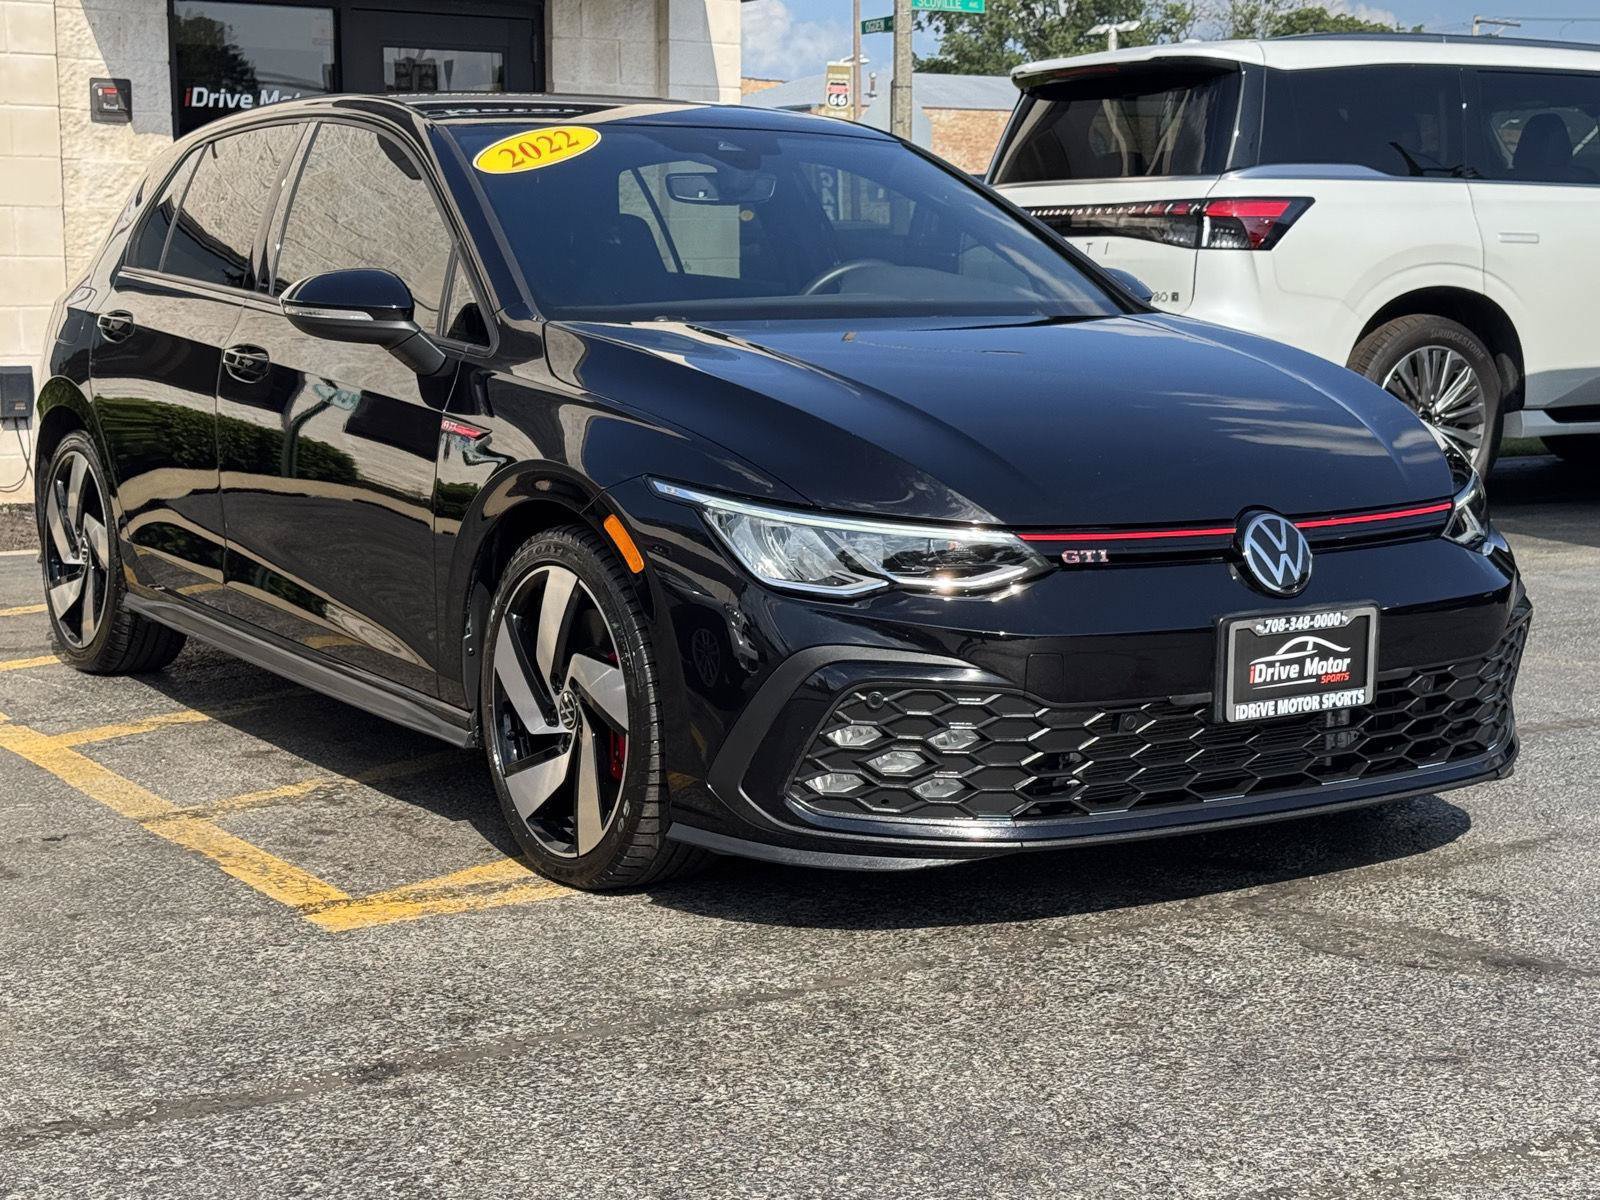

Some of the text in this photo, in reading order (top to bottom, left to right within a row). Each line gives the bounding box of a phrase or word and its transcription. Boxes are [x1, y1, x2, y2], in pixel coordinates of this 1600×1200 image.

[184, 87, 254, 109] iDrive
[829, 94, 847, 106] 66
[498, 130, 580, 168] 2022
[1061, 549, 1109, 564] GTI
[1265, 612, 1341, 633] 708-348-0000
[1249, 657, 1351, 684] iDrive Motor
[1321, 673, 1349, 683] SPORTS
[1277, 695, 1321, 716] MOTOR
[1322, 689, 1365, 709] SPORTS
